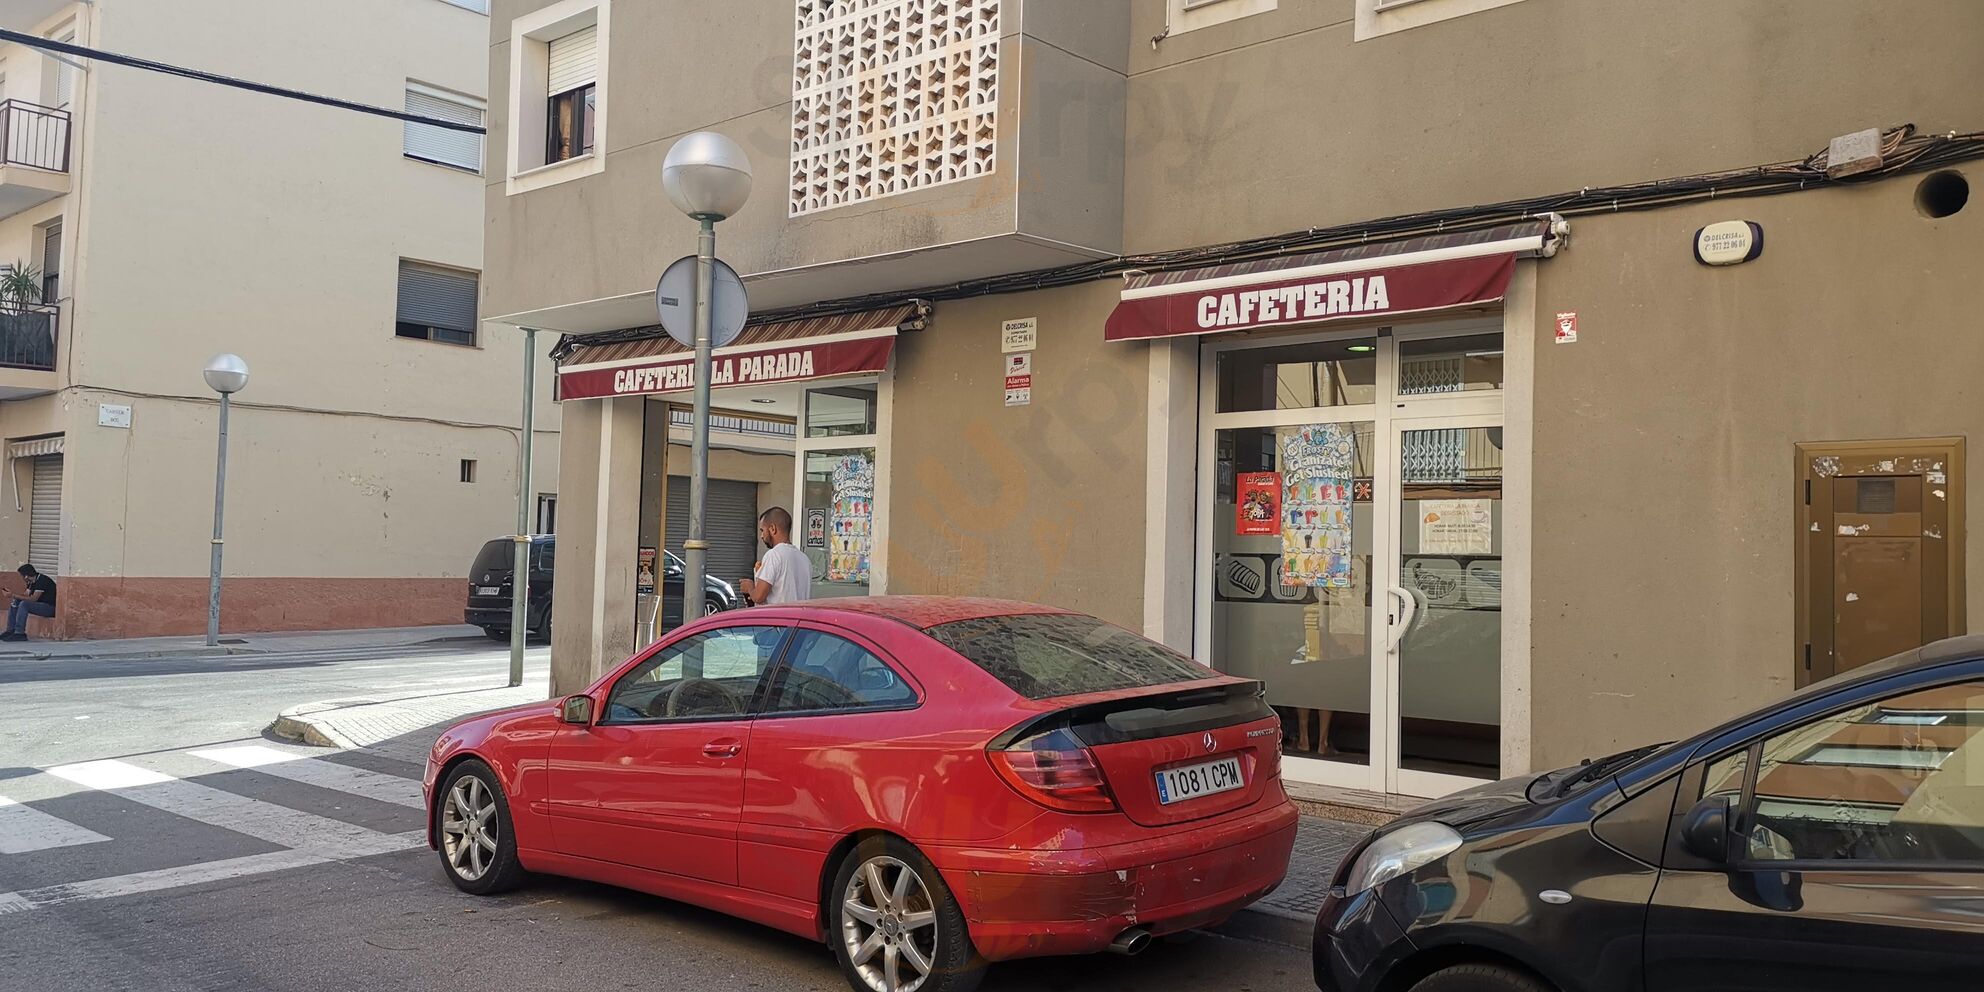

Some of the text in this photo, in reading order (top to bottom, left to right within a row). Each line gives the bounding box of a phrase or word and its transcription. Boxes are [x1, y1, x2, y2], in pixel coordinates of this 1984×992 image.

[1197, 275, 1390, 328] CAFETERIA
[614, 350, 814, 394] CAFETERI LA PARADA
[1007, 377, 1030, 385] Alarma
[1303, 446, 1333, 457] FROSTY
[1290, 456, 1345, 471] Granizate
[1286, 471, 1305, 487] Get
[1169, 761, 1239, 798] 1081 CPM
